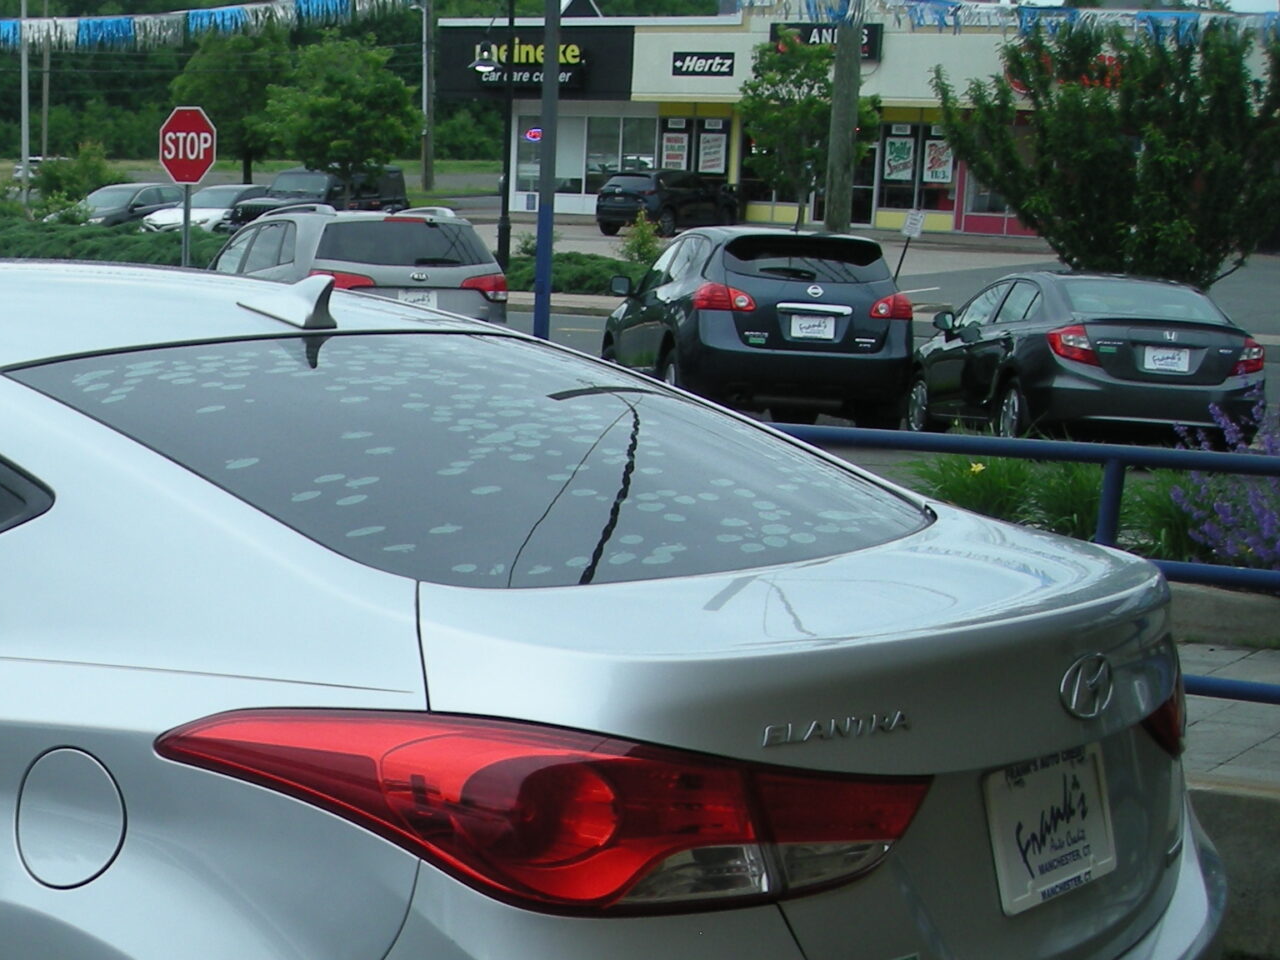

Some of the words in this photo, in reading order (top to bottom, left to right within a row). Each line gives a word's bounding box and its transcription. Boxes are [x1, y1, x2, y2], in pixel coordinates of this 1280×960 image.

[681, 56, 733, 72] Hertz
[482, 72, 501, 82] car
[164, 132, 212, 160] STOP
[762, 710, 910, 749] ELANTRA
